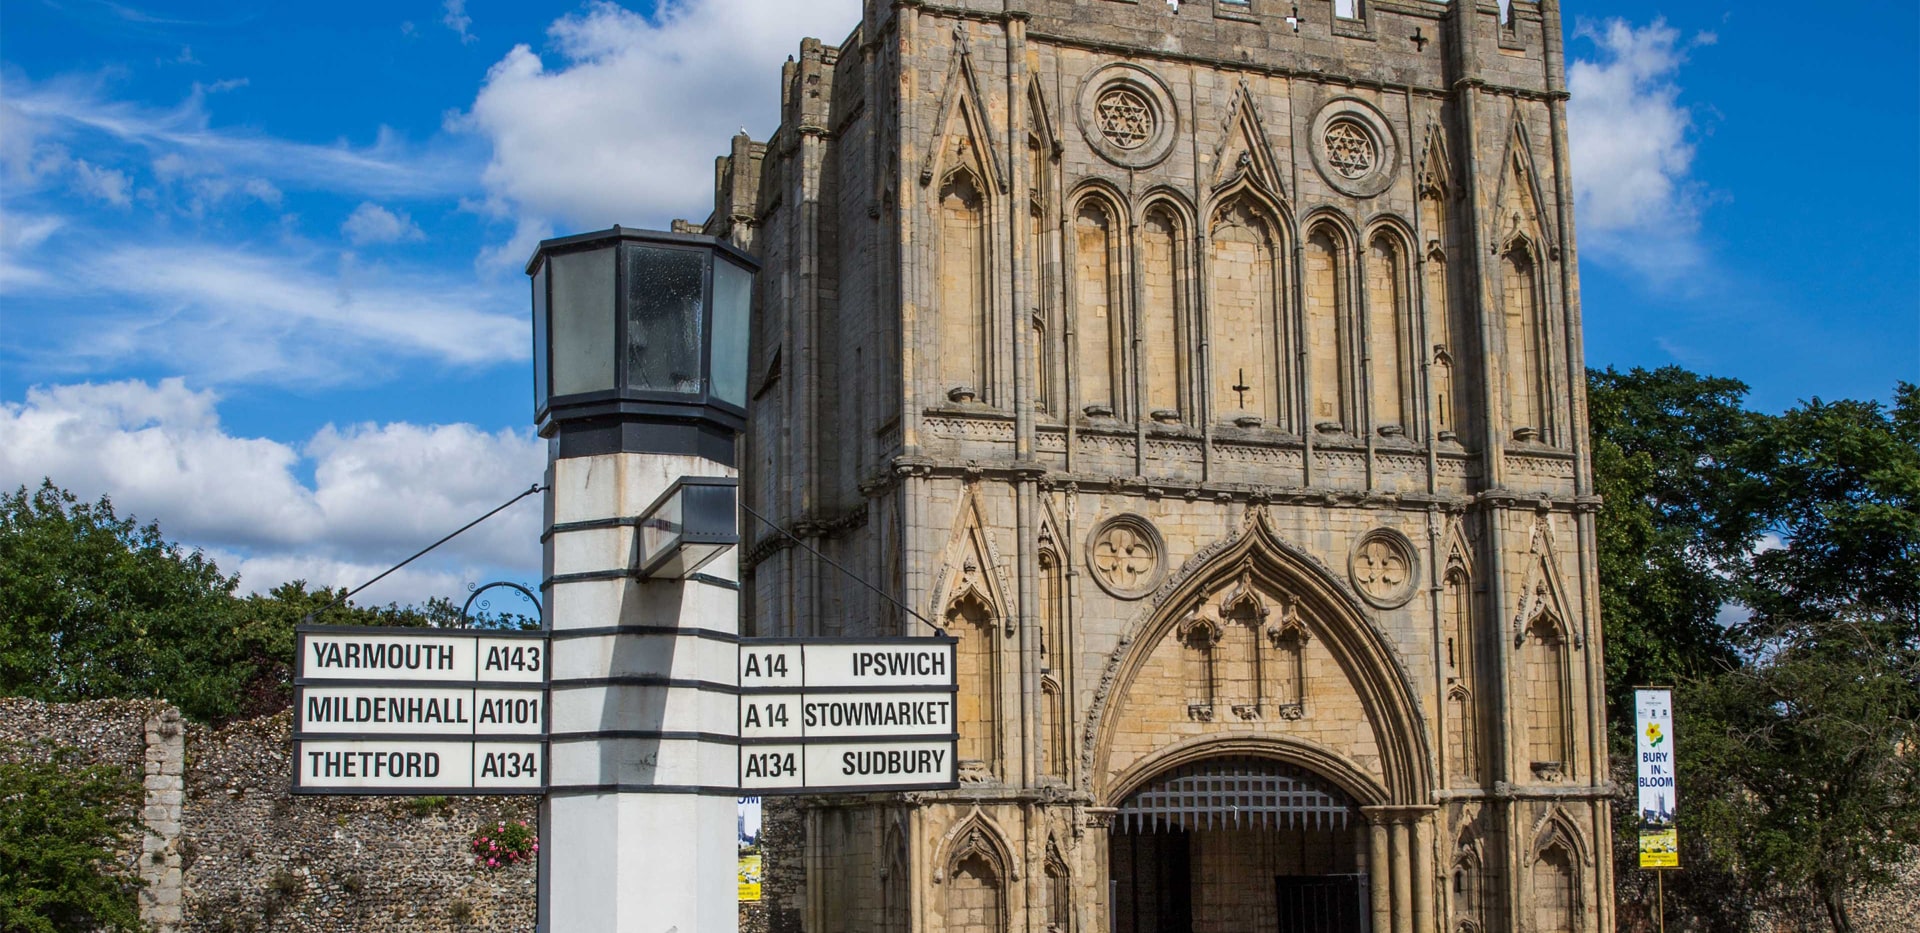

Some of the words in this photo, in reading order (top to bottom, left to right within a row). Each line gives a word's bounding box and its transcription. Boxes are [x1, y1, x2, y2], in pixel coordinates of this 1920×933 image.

[312, 642, 454, 670] YARMOUTH
[485, 646, 540, 672] A143
[852, 652, 945, 677] IPSWICH
[308, 696, 469, 724] MILDENHALL
[479, 698, 538, 724] A1101
[804, 701, 950, 727] STOWMARKET
[308, 751, 440, 778] THETFORD
[481, 752, 538, 778] A134
[745, 752, 797, 778] A134
[842, 749, 945, 776] SUDBURY
[1642, 751, 1668, 763] BURY
[1650, 764, 1661, 775] IN
[1639, 776, 1674, 788] BLOOM
